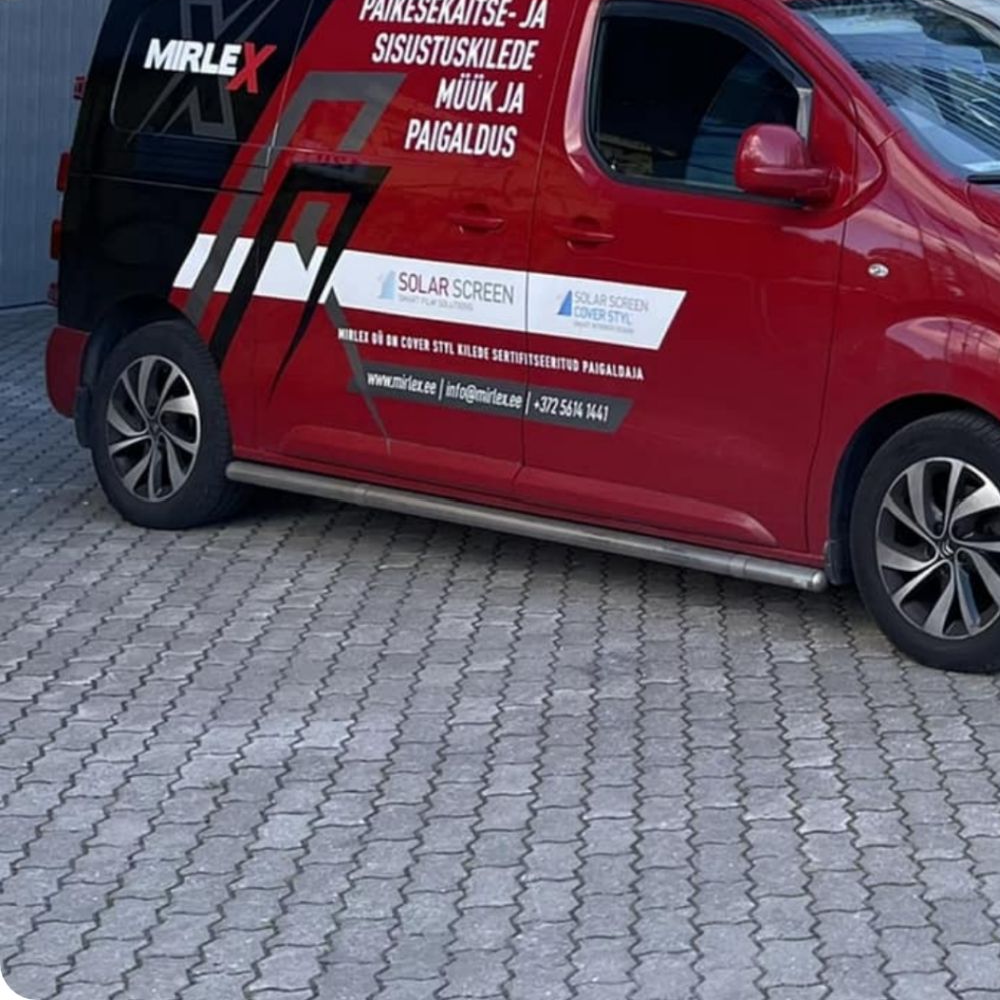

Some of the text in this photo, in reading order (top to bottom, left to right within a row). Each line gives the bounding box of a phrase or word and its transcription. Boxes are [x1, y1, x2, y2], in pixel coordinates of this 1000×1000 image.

[143, 38, 277, 94] MIRLEX
[371, 33, 539, 71] SISUSTUSKILEDE
[435, 73, 525, 114] MÜÜK JA
[404, 119, 517, 159] PAIGALDUS
[398, 271, 514, 305] SOLAR SCREEN
[337, 327, 369, 343] MIRLEX
[400, 335, 430, 351] COVER
[433, 339, 455, 355] STYL
[457, 343, 489, 360] KILEDE
[492, 348, 580, 372] SERTIFITSEERITUD
[582, 360, 644, 381] PAIGALDAJA
[367, 373, 437, 395] www.mirlex.ee
[446, 380, 523, 409] info@mirlex.ee
[534, 396, 558, 415] +372
[559, 398, 584, 418] 5614
[586, 402, 610, 422] 1441
